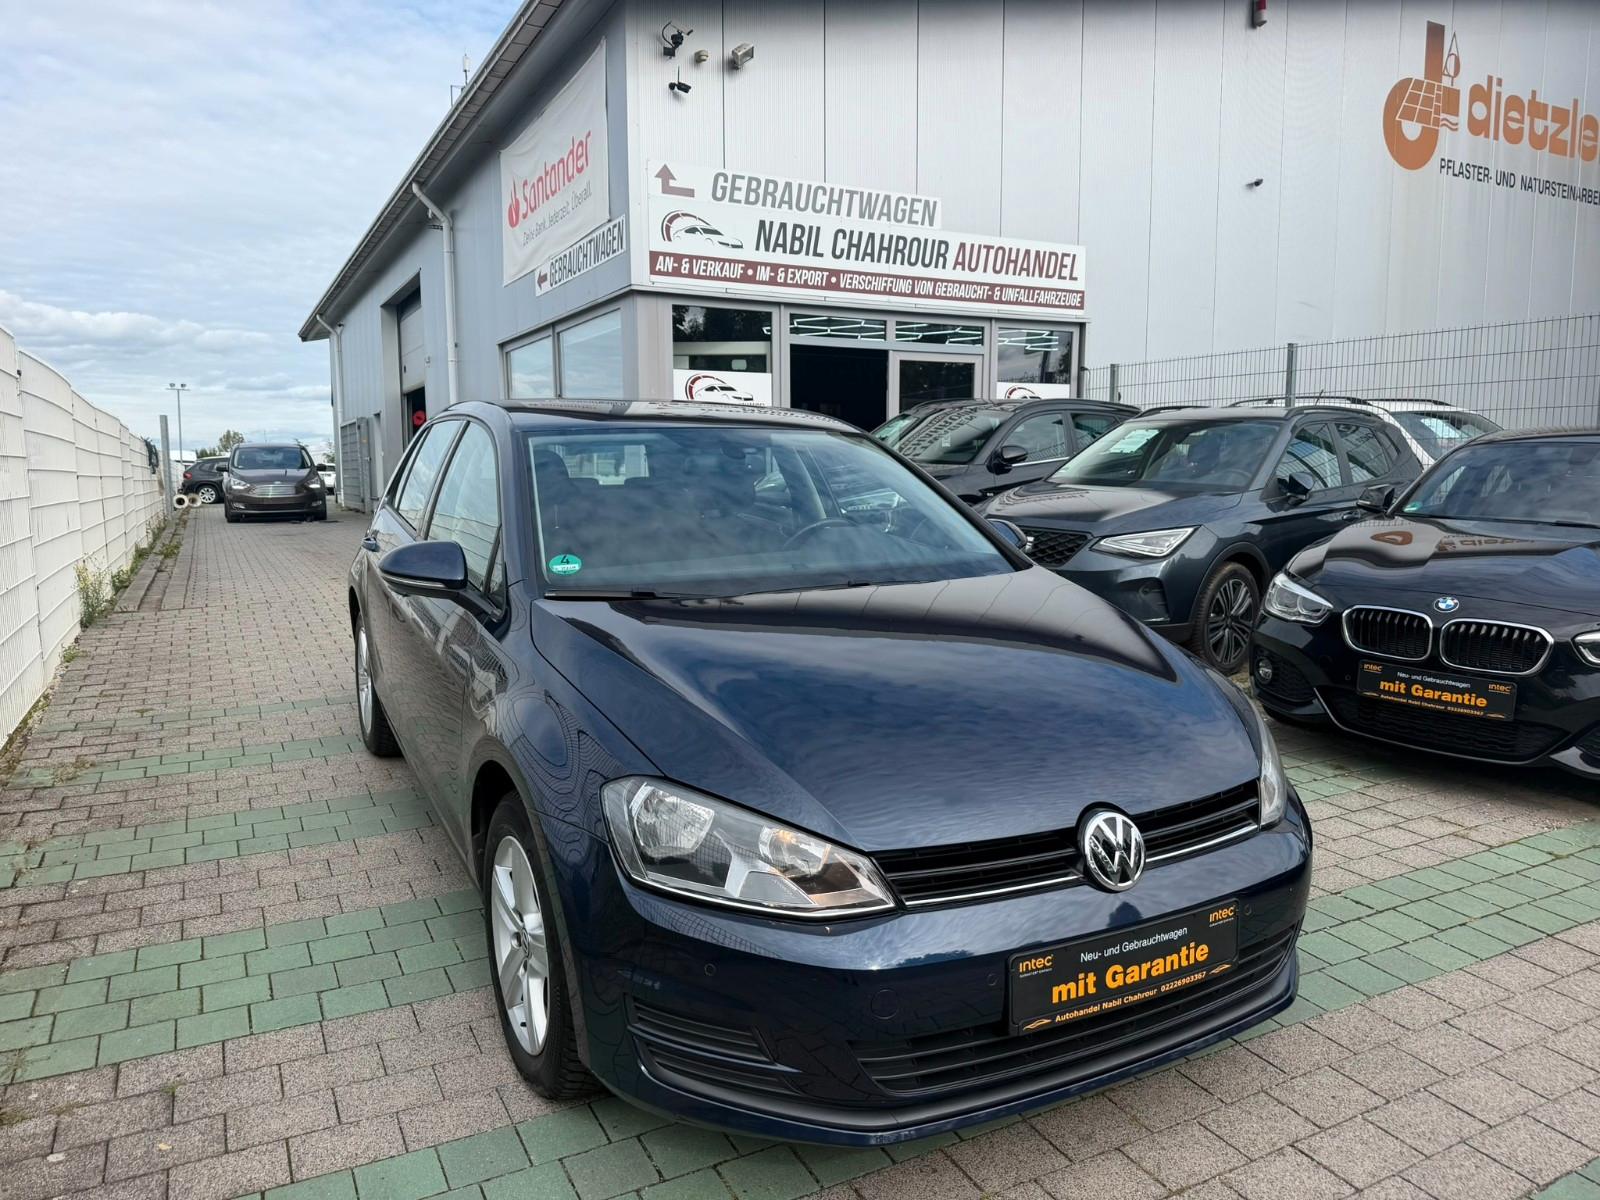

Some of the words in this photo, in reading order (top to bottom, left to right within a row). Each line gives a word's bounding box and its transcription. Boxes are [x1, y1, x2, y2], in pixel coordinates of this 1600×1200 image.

[522, 130, 591, 220] Santander
[711, 171, 938, 227] GEBRAUCHTWAGEN
[1440, 158, 1492, 184] PFLASTER-
[1495, 170, 1516, 188] UND
[550, 219, 624, 288] GEBRAUCHTWAGEN
[755, 219, 825, 258] NABIL
[831, 228, 950, 270] CHAHROUR
[952, 242, 1079, 281] AUTOHANDEL
[655, 255, 679, 273] AN-
[681, 258, 690, 274] &
[692, 259, 745, 279] VERKAUF
[756, 265, 775, 282] IM-
[777, 268, 785, 283] &
[787, 268, 829, 287] EXPORT
[839, 273, 912, 294] VERSCHIFFUNG
[914, 280, 933, 296] VON
[935, 281, 992, 300] GEBRAUCHT-
[994, 287, 1001, 301] &
[1002, 288, 1083, 307] UNFALLFAHRZEUGE
[561, 554, 570, 564] 4
[1380, 680, 1407, 694] mit
[1411, 684, 1488, 707] Garantie
[1080, 952, 1102, 963] Neu-
[1104, 944, 1120, 957] und
[1122, 927, 1188, 952] Gebrauchtwagen
[1052, 972, 1097, 1004] mit
[1105, 941, 1209, 989] Garantie
[1055, 1004, 1101, 1022] Autohandel
[1102, 998, 1122, 1010] Nabil
[1123, 988, 1158, 1004] Chahrour
